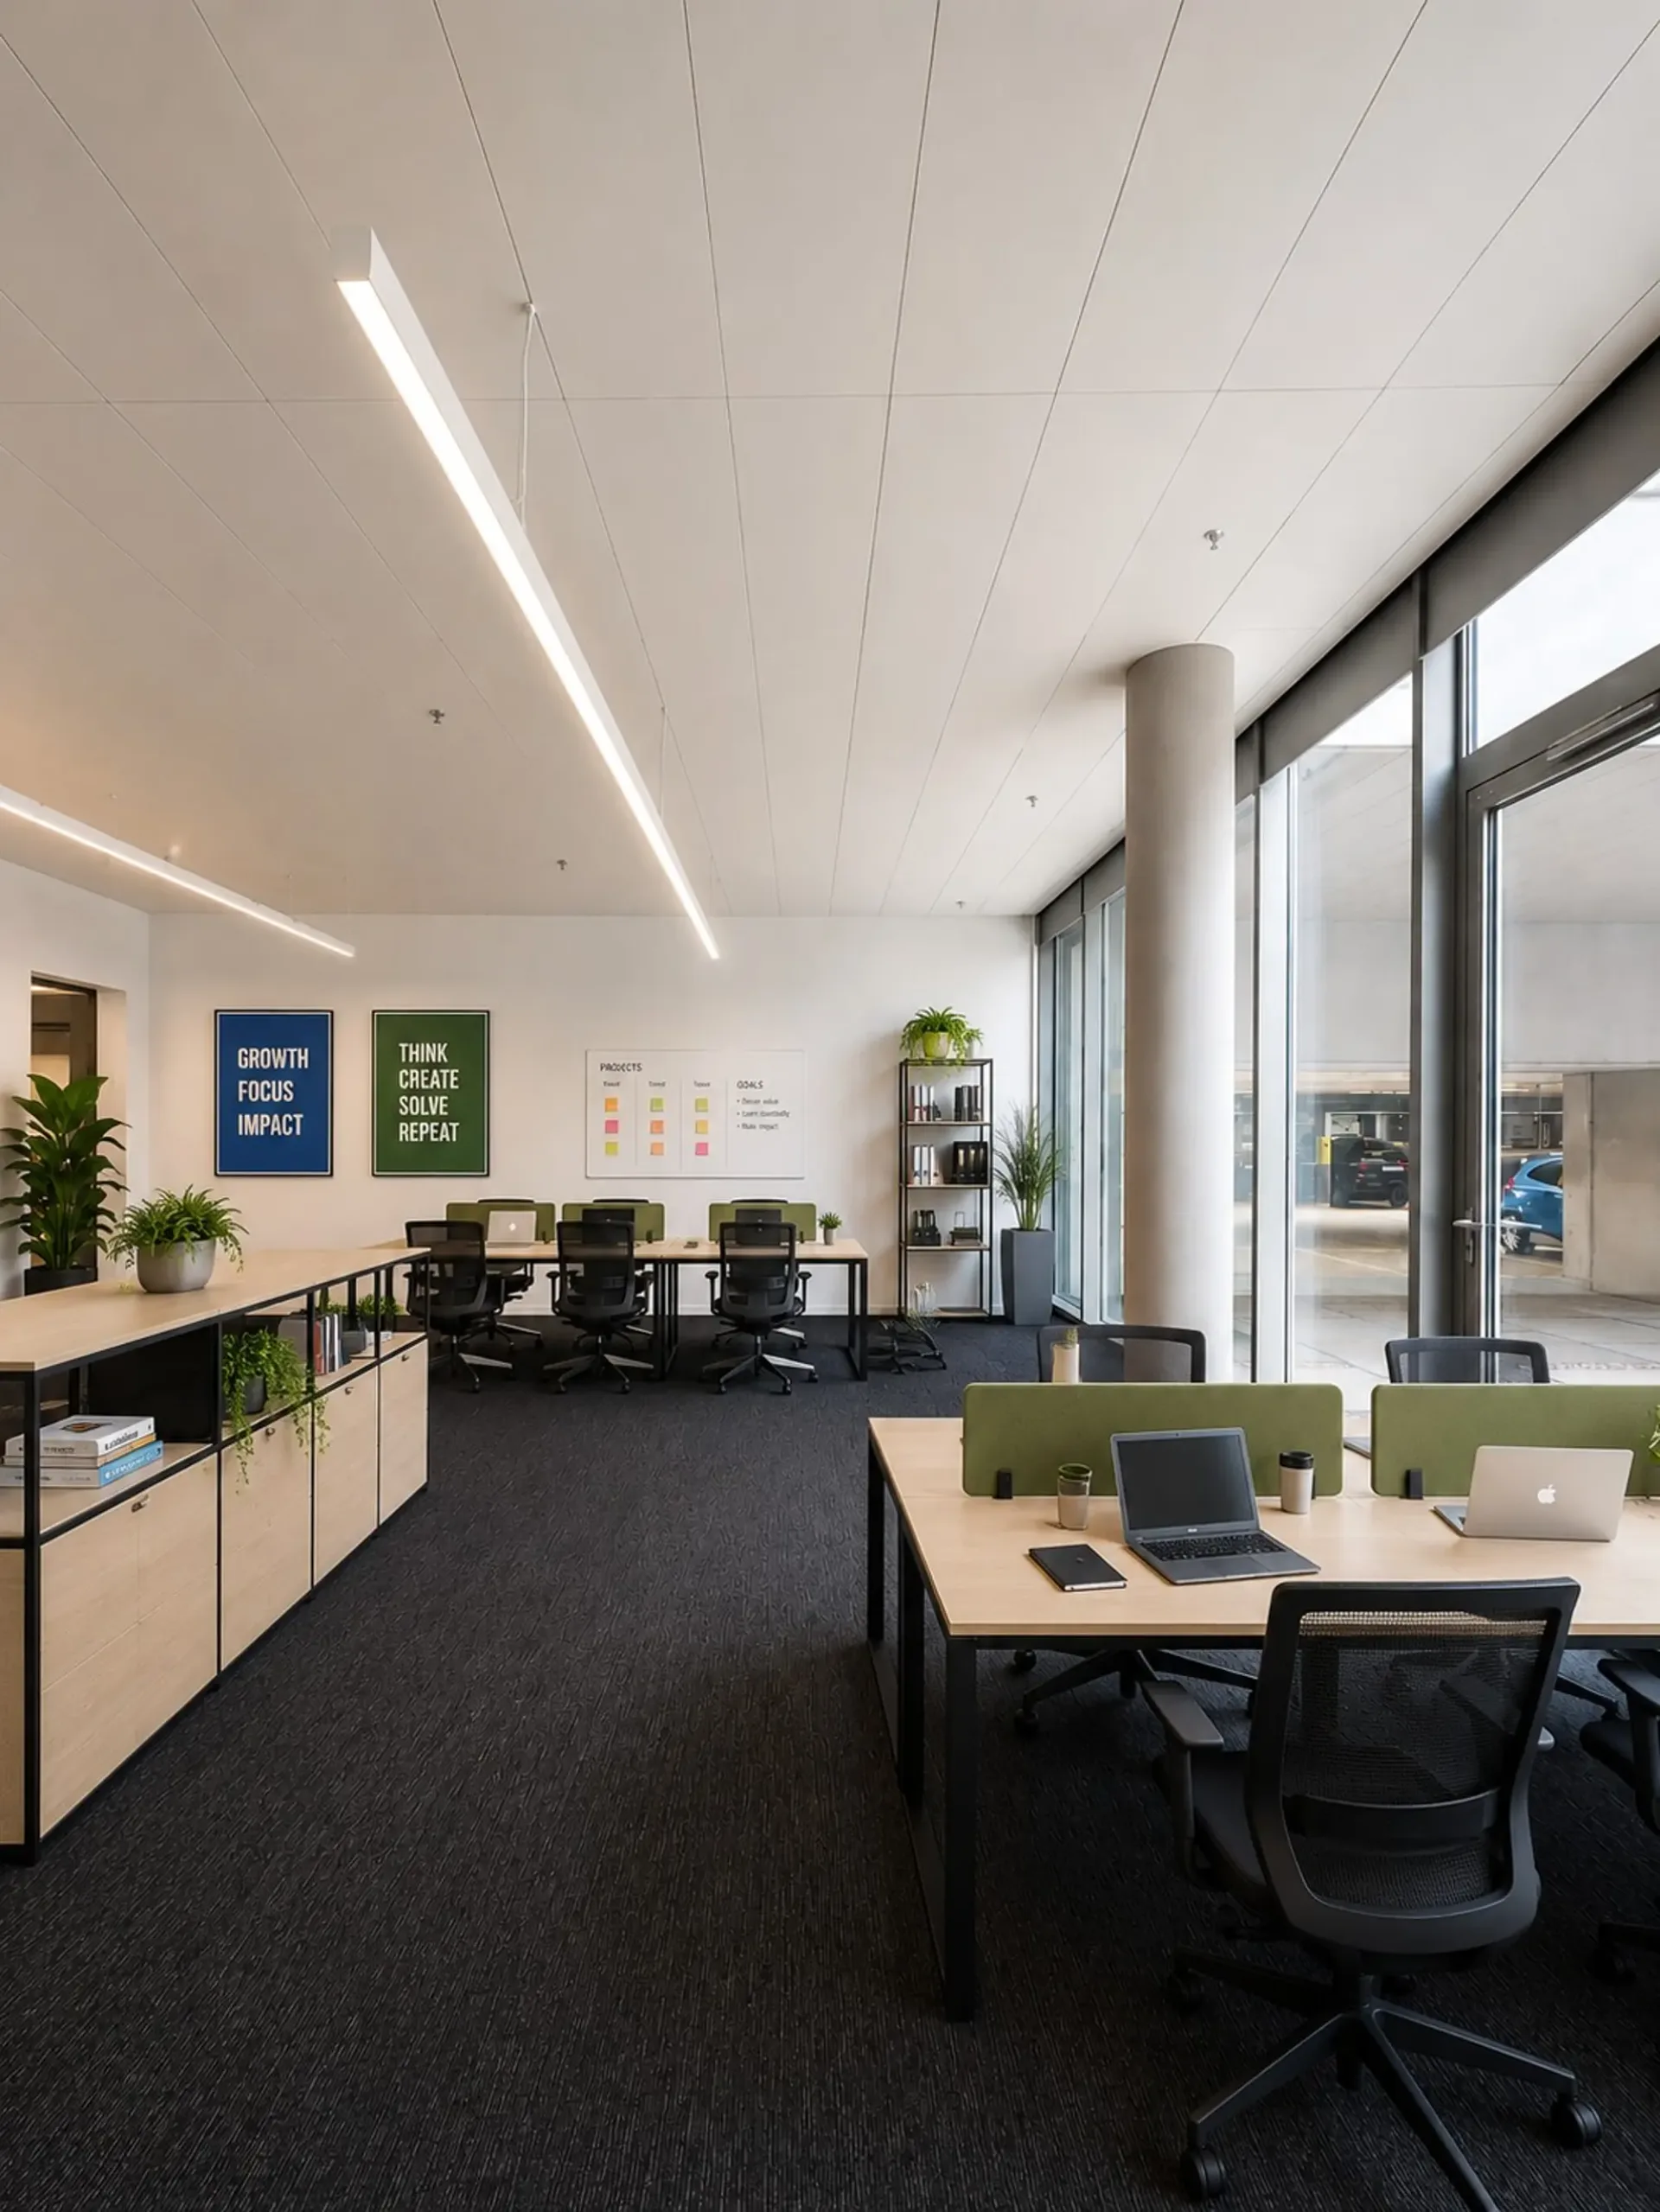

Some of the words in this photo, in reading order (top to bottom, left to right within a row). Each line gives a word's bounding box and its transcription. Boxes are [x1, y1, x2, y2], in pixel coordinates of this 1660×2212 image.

[238, 1048, 309, 1069] GROWTH
[399, 1042, 448, 1063] THINK
[399, 1069, 459, 1089] CREATE
[737, 1080, 763, 1089] GOALS
[238, 1080, 294, 1102] FOCUS
[399, 1095, 448, 1115] SOLVE
[238, 1113, 303, 1136] IMPACT
[399, 1122, 459, 1142] REPEAT
